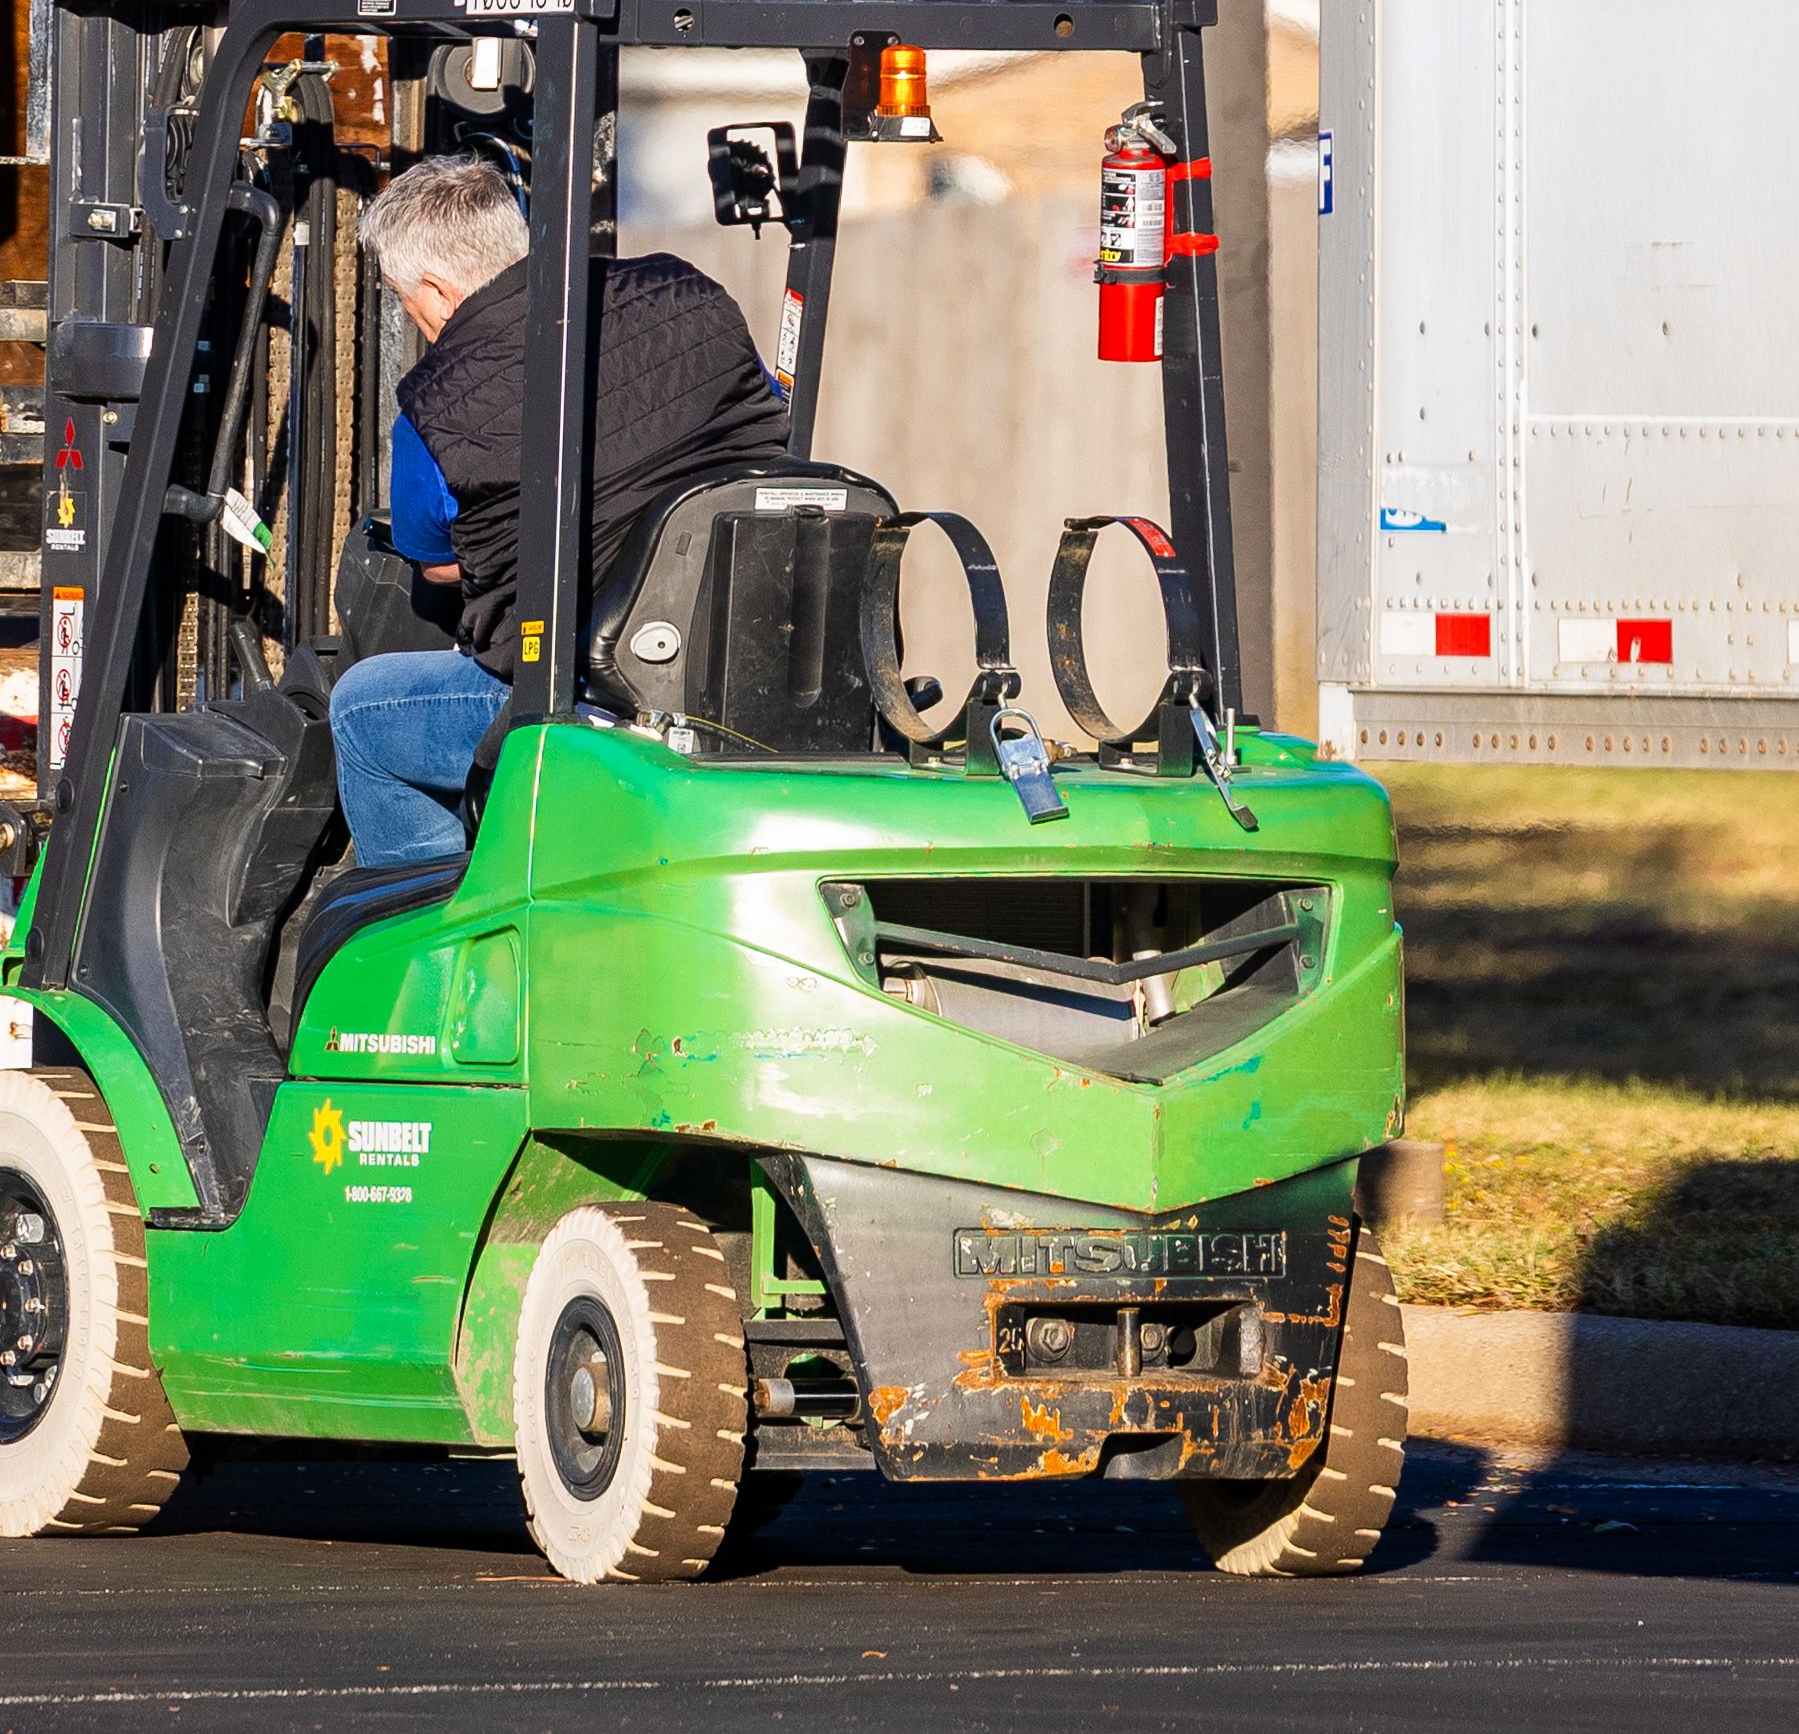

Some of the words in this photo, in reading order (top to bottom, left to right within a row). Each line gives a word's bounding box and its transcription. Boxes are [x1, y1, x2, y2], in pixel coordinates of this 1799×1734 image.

[524, 641, 538, 655] LPG
[340, 1033, 436, 1054] MITSUBISHI
[348, 1121, 432, 1153] SUNBELT
[360, 1153, 419, 1166] RENTALS
